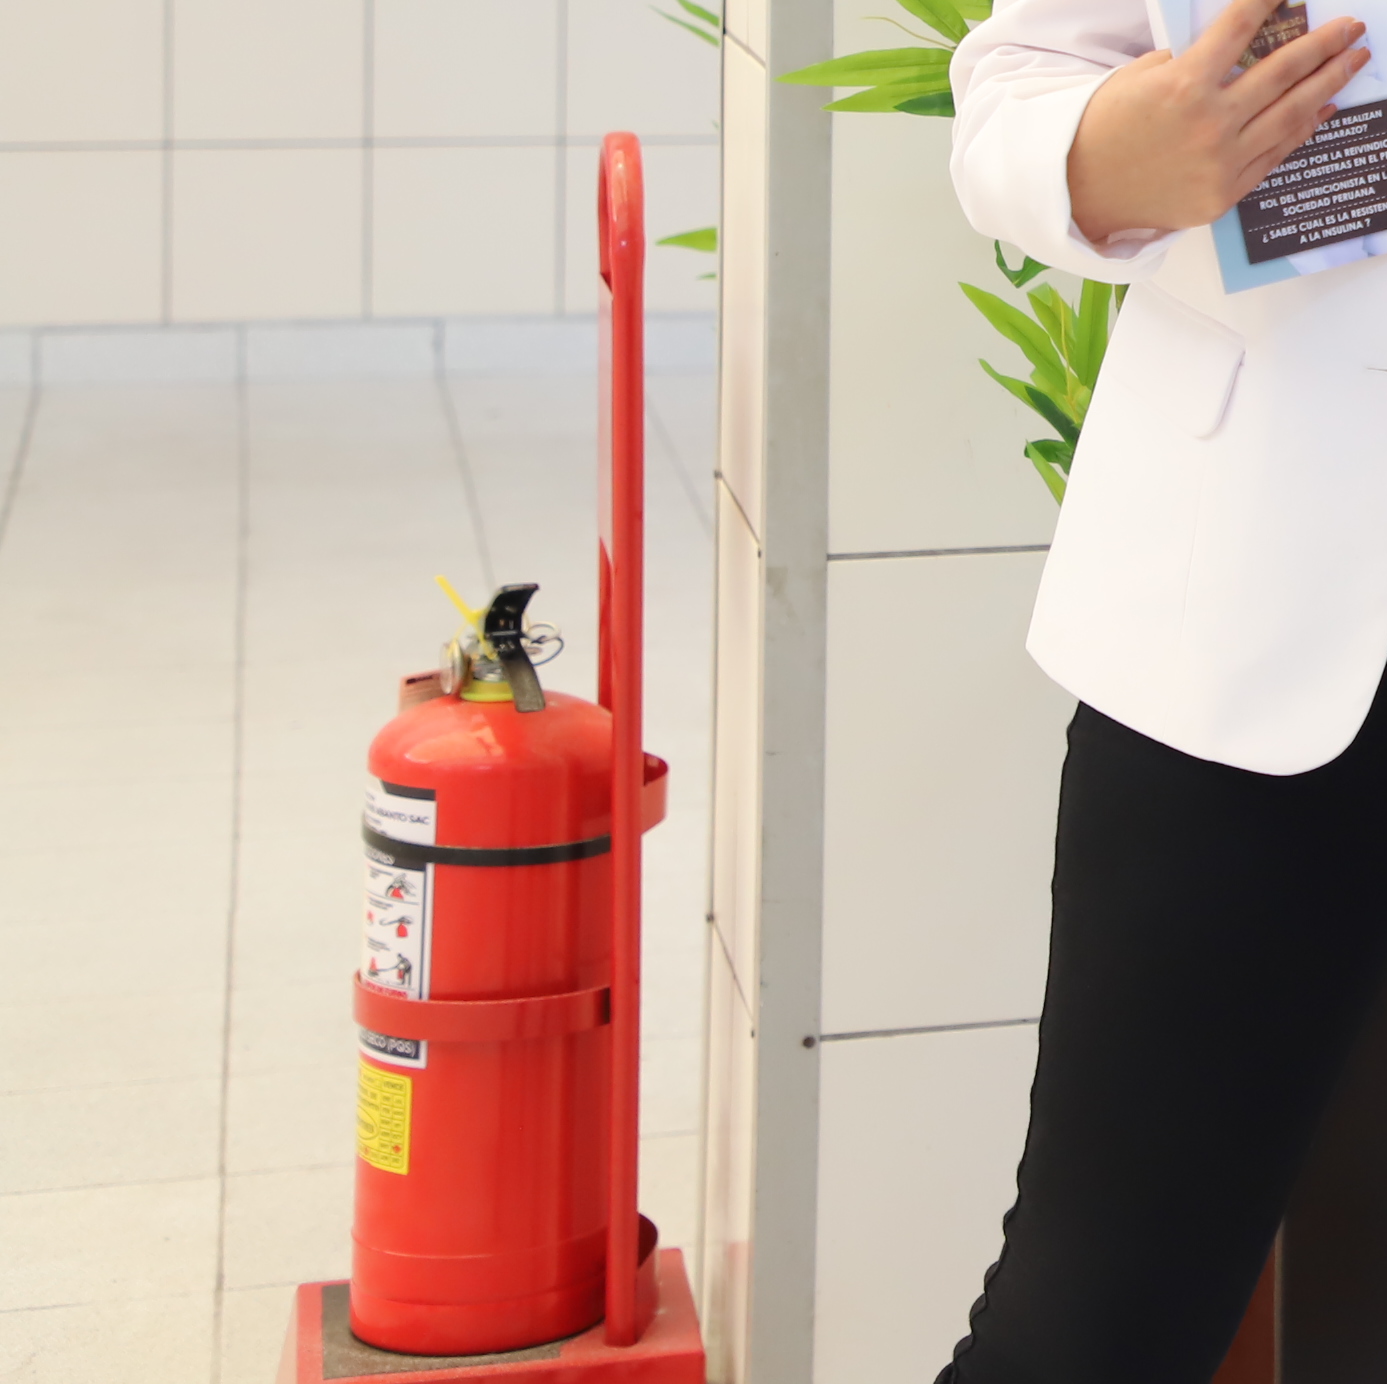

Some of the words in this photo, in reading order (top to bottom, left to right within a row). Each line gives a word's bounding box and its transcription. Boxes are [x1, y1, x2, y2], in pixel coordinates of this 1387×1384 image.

[1330, 120, 1341, 129] SE
[1342, 109, 1382, 126] REALIZAN
[1315, 124, 1368, 144] EMBARAZO?
[1309, 154, 1329, 166] POR
[1330, 149, 1342, 161] LA
[1271, 177, 1284, 188] DE
[1285, 173, 1302, 184] LAS
[1303, 159, 1352, 179] OBSTETRAS
[1354, 157, 1367, 166] EN
[1368, 154, 1378, 164] EL
[1259, 199, 1278, 210] ROL
[1280, 195, 1297, 205] DEL
[1297, 177, 1366, 201] NUTRICIONISTA
[1367, 173, 1380, 183] EN
[1282, 197, 1331, 216] SOCIEDAD
[1332, 186, 1376, 204] PERUANA
[1269, 226, 1298, 239] SABES
[1298, 220, 1324, 232] CUAL
[1325, 216, 1337, 224] ES
[1337, 211, 1350, 222] LA
[1300, 235, 1308, 244] A
[1309, 231, 1321, 241] LA
[1322, 222, 1363, 238] INSULINA
[388, 1038, 416, 1057] (PQS)
